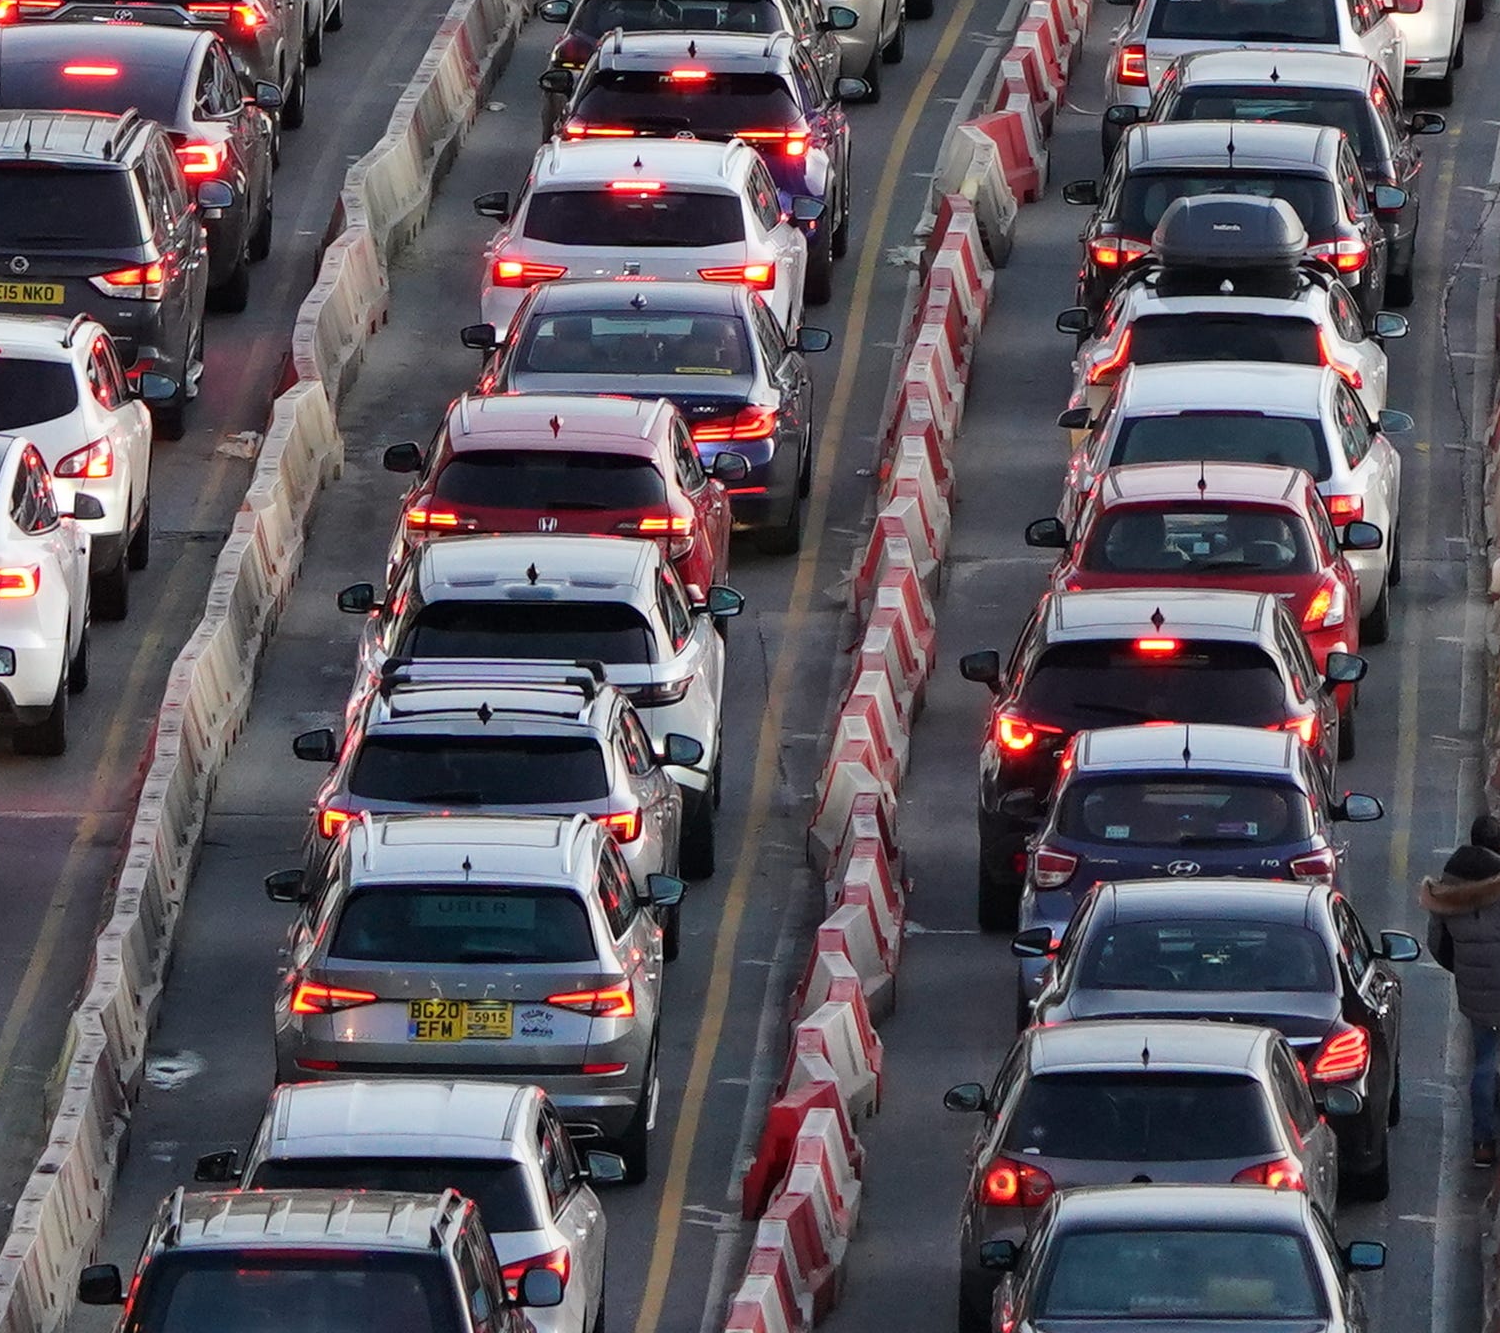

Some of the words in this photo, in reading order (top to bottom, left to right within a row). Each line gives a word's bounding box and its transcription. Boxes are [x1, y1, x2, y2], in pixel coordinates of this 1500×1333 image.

[22, 287, 54, 300] NKO
[439, 899, 507, 914] UBER
[411, 1002, 459, 1020] BG20
[474, 1012, 507, 1024] 5915
[417, 1021, 453, 1038] EFM
